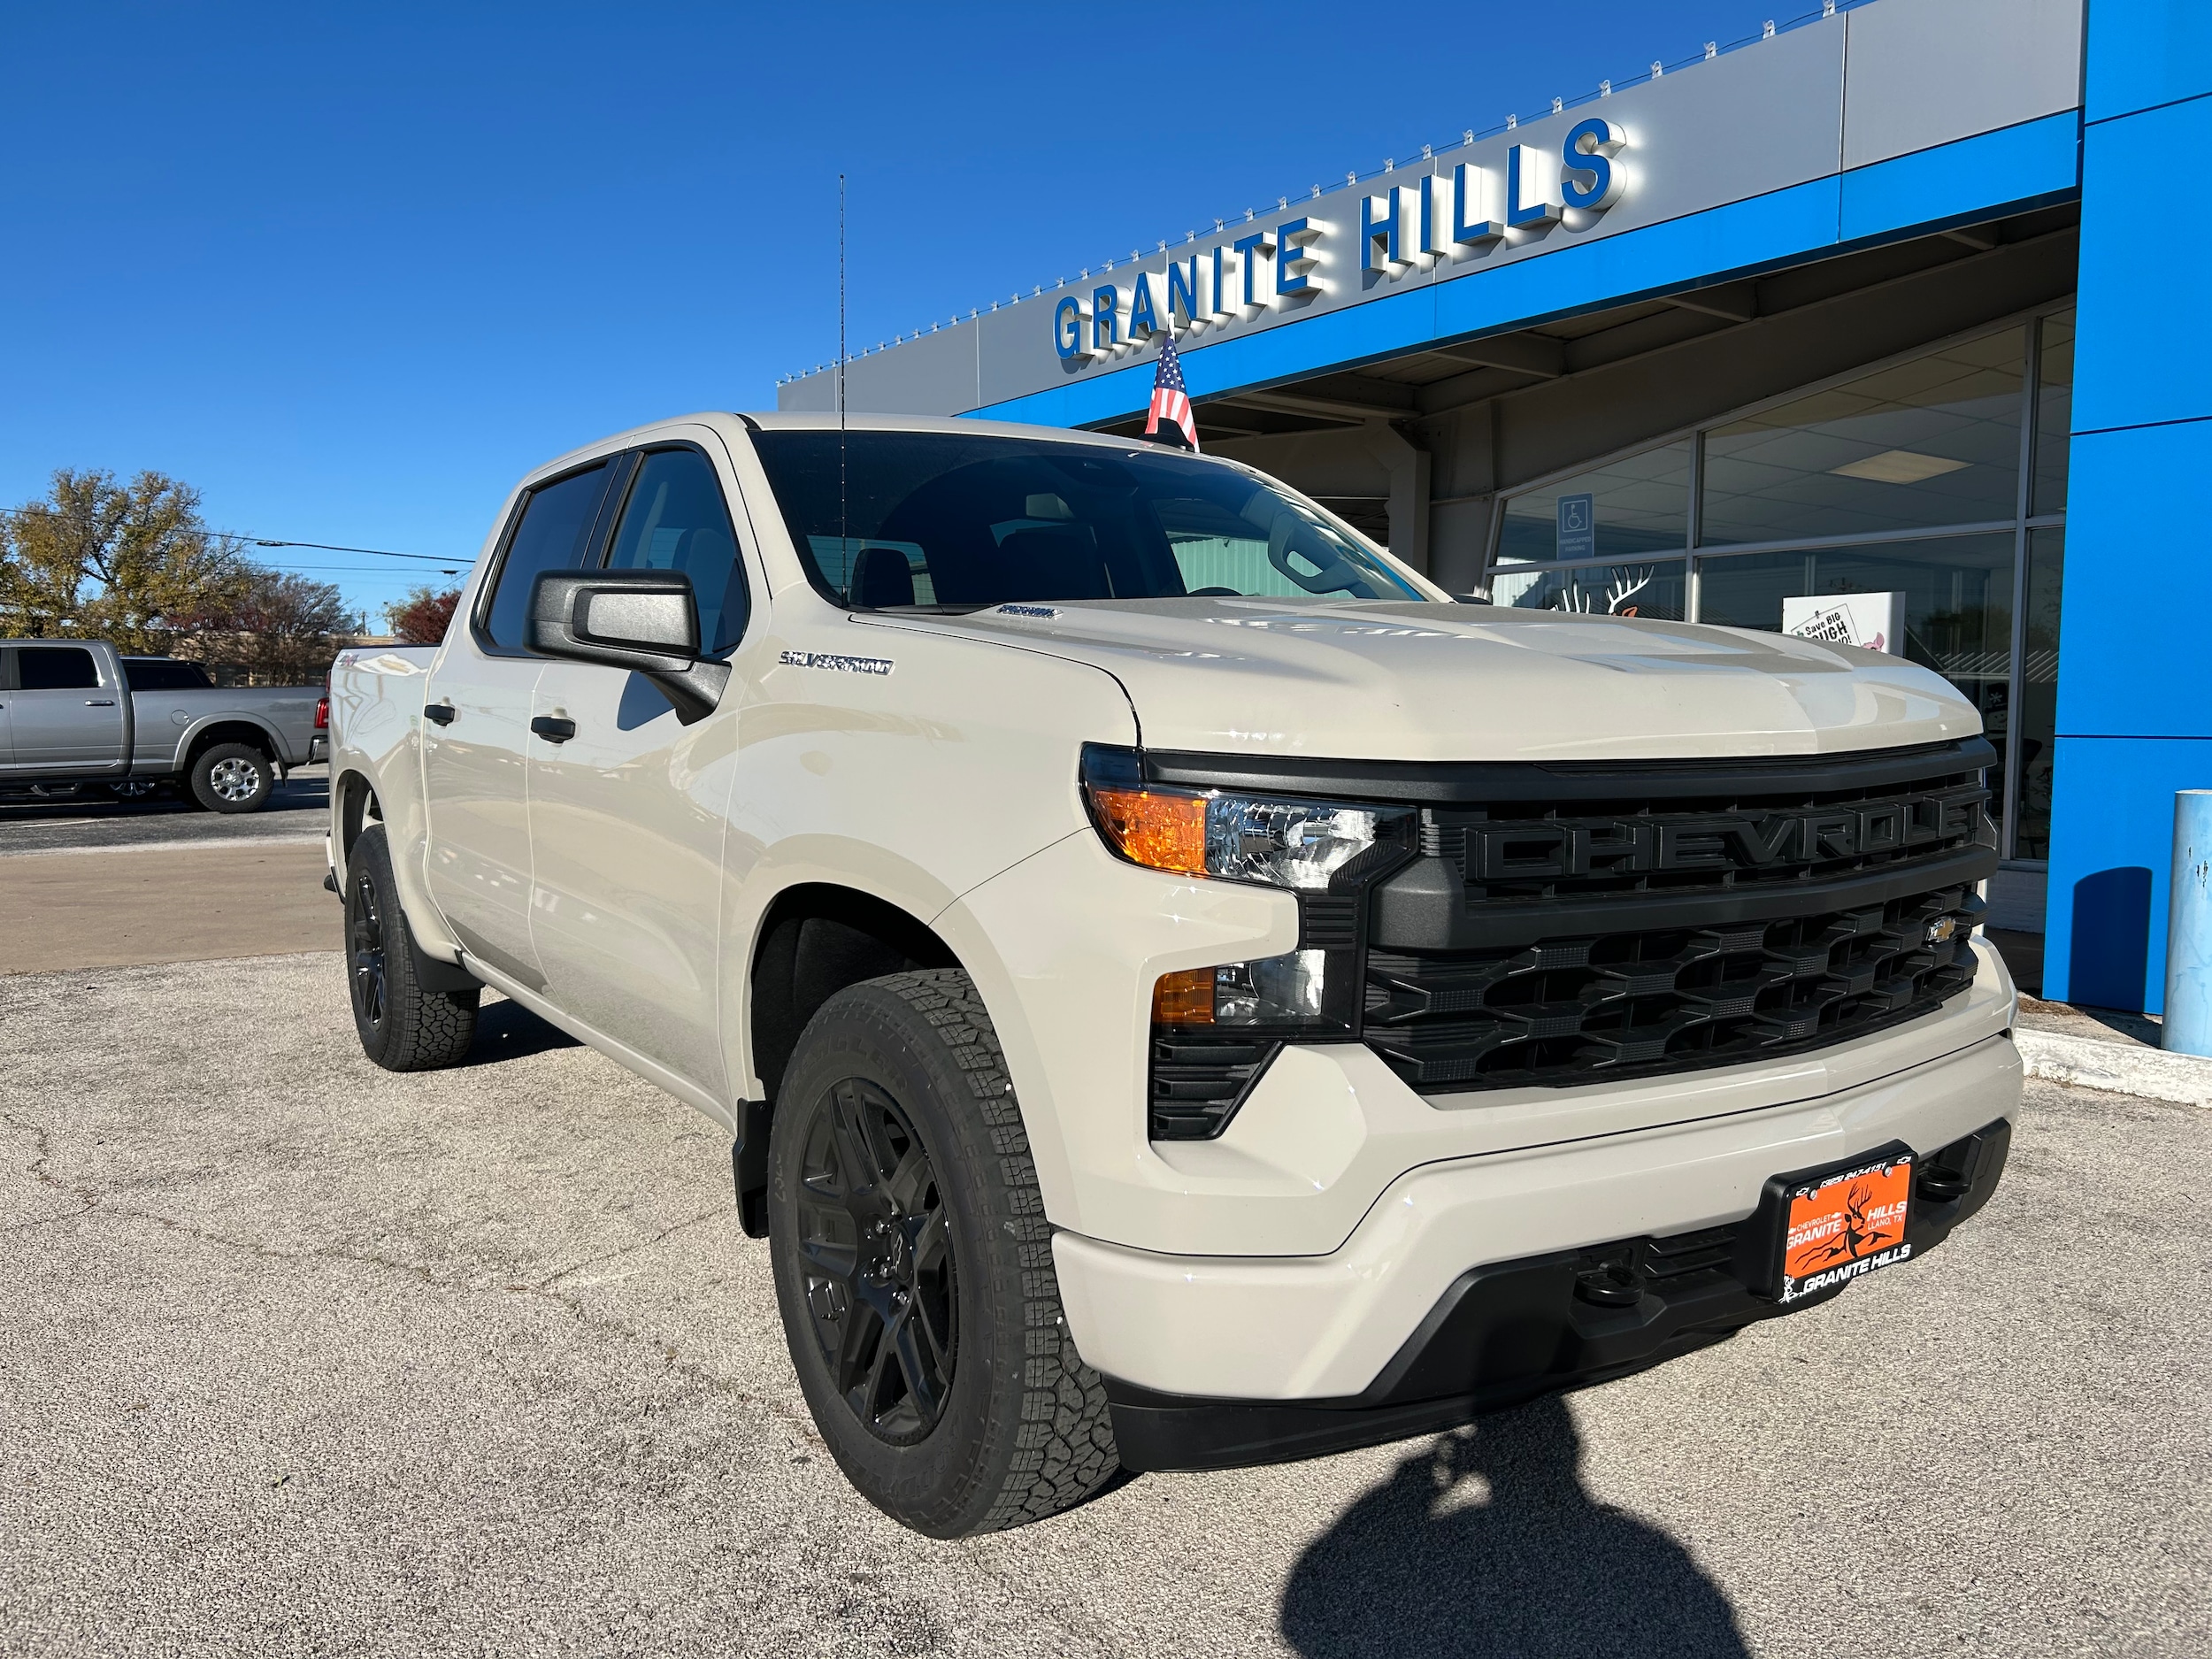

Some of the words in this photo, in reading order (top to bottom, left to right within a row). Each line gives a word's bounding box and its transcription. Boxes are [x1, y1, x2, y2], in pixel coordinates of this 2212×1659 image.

[1054, 216, 1325, 360] GRANITE
[1361, 117, 1621, 273] HILLS
[1805, 621, 1825, 635] Save
[1826, 612, 1840, 625] BIG
[1786, 1218, 1842, 1250] GRANITE
[1866, 1201, 1908, 1221] HILLS
[1796, 1213, 1832, 1232] CHEVROLET
[1867, 1218, 1891, 1231] LLANO,
[1893, 1214, 1903, 1223] TX
[1802, 1257, 1871, 1293] GRANITE
[1870, 1243, 1912, 1270] HILLS
